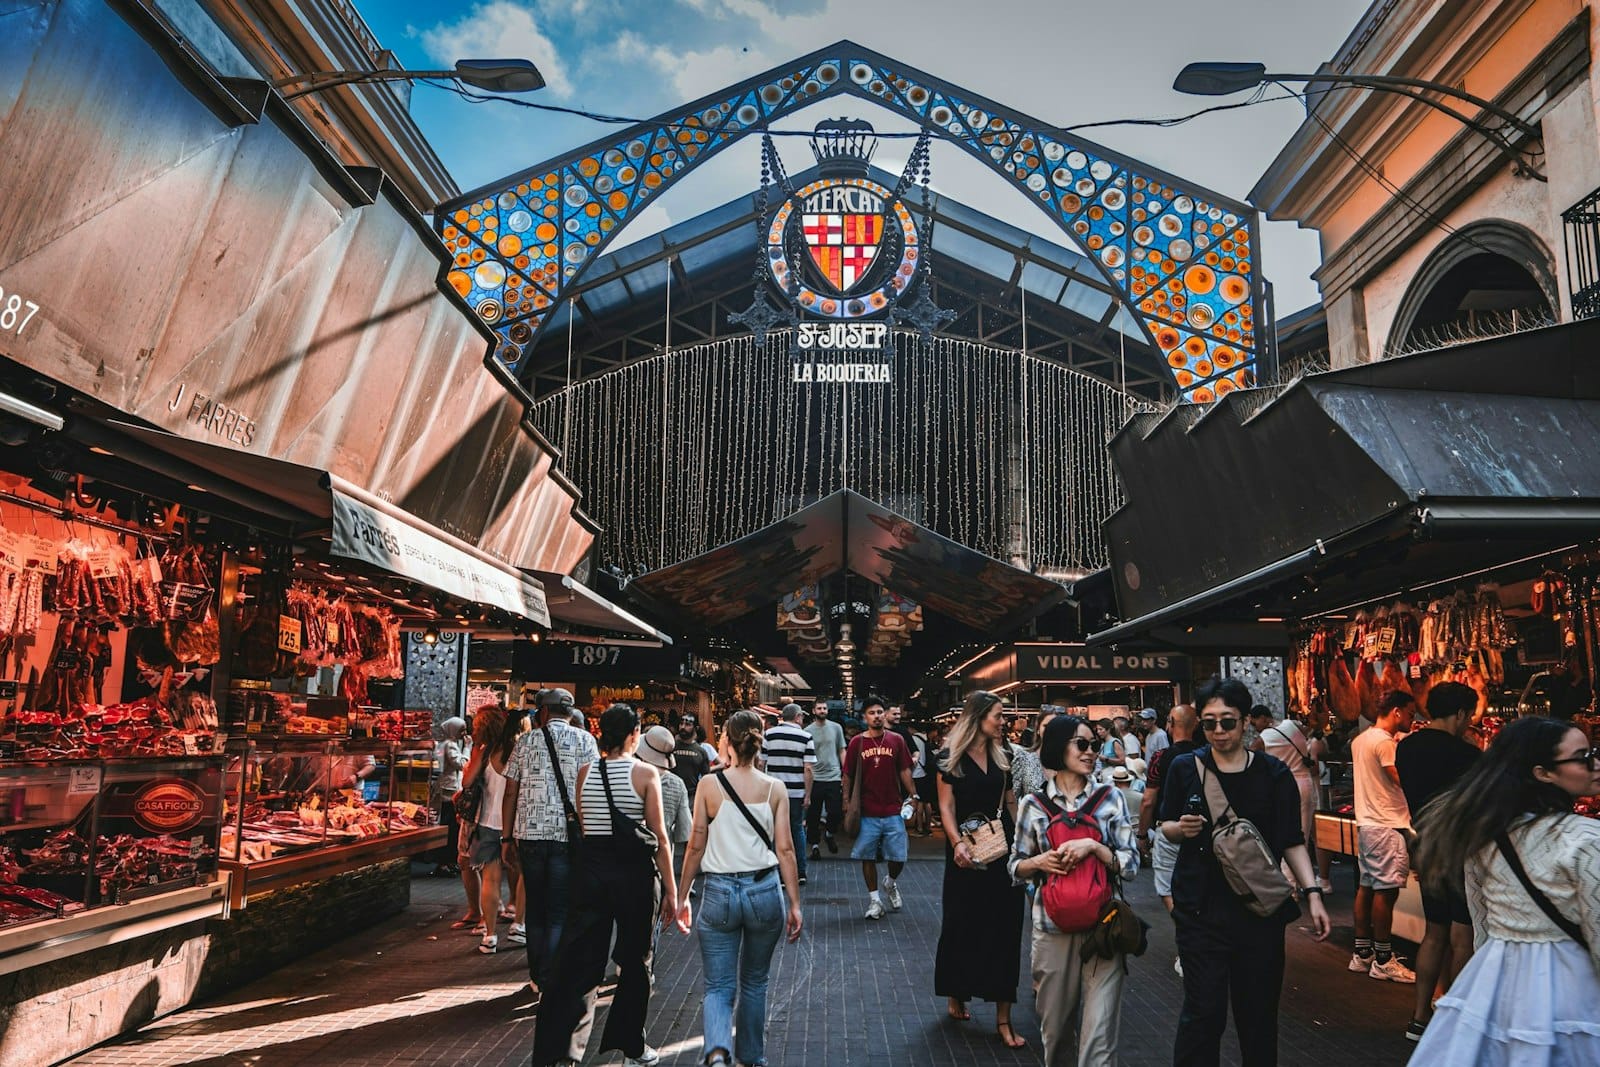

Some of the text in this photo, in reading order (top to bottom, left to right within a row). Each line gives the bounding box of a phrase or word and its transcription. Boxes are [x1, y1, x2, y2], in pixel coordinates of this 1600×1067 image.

[802, 187, 882, 213] MERCAT
[818, 323, 887, 348] JOSEP
[793, 363, 890, 382] LA BOQUERIA
[279, 629, 296, 648] 125
[571, 646, 621, 665] 1897
[1037, 655, 1170, 669] VIDAL PONS
[137, 801, 164, 810] CASA
